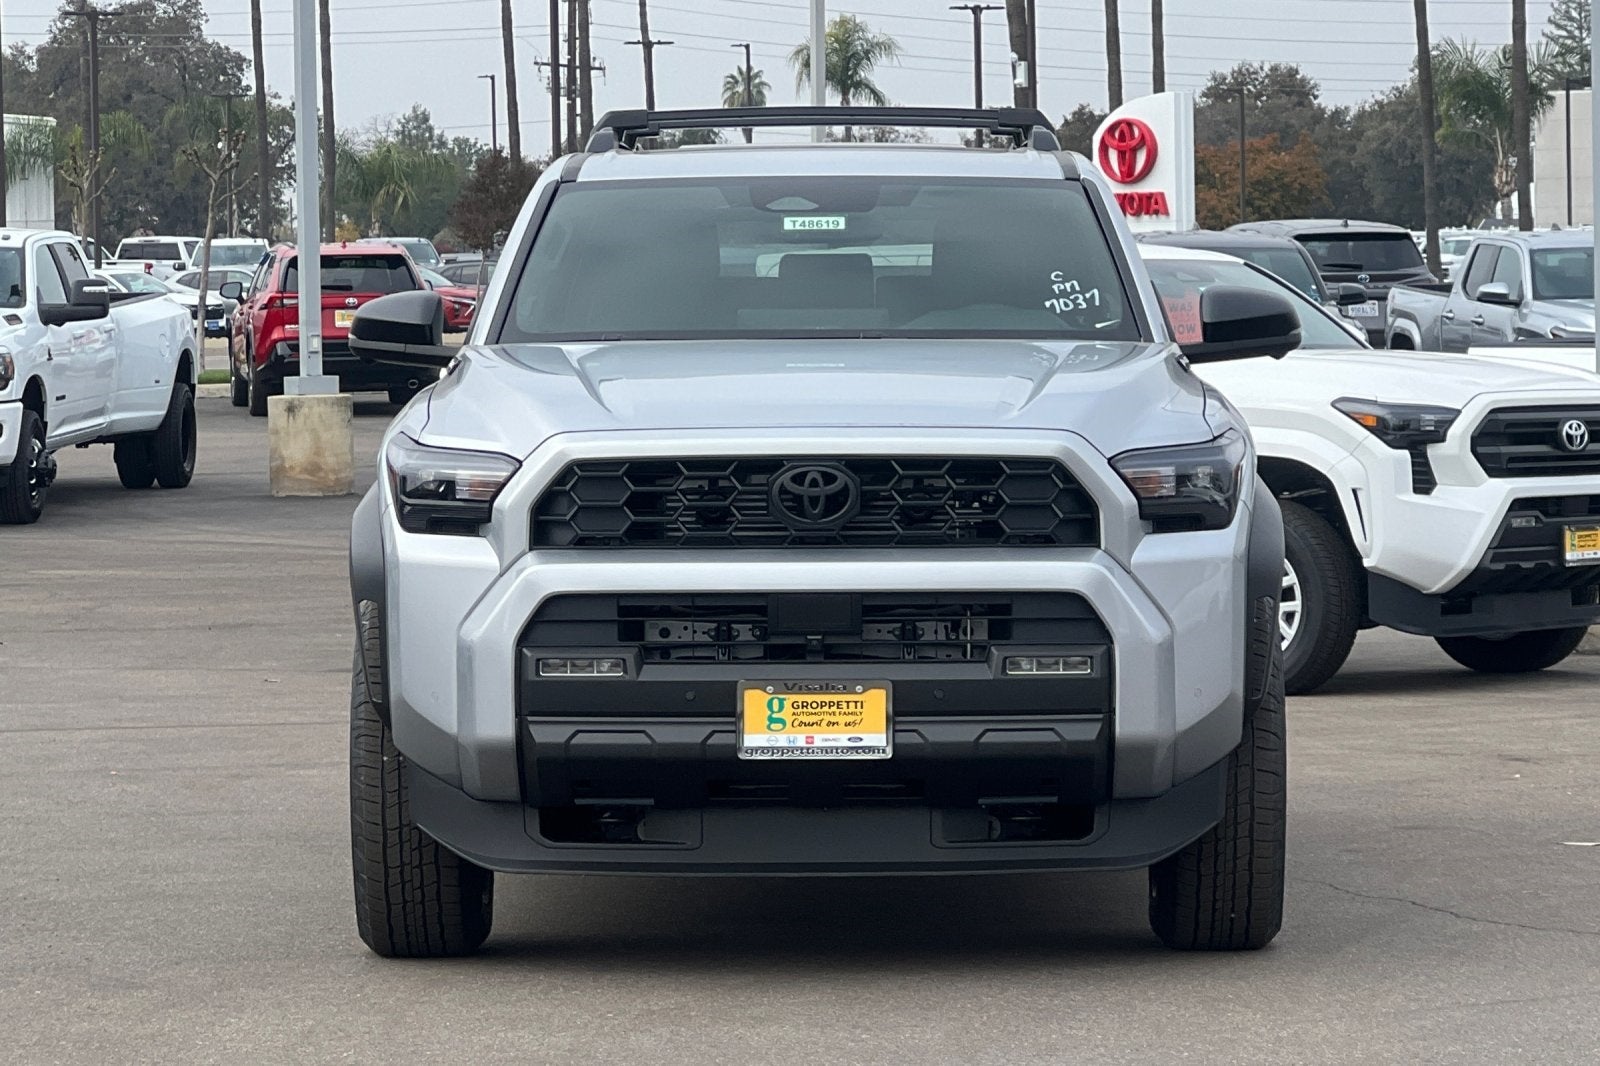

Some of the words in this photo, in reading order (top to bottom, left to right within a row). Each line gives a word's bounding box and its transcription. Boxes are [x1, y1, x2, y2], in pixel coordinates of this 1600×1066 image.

[1113, 192, 1170, 217] YOTA
[789, 219, 840, 229] T48619
[783, 682, 847, 692] Visalia
[791, 700, 864, 710] GROPPETTI
[791, 717, 824, 728] Count
[844, 717, 864, 728] us!
[744, 747, 886, 758] groppettiauto.com
